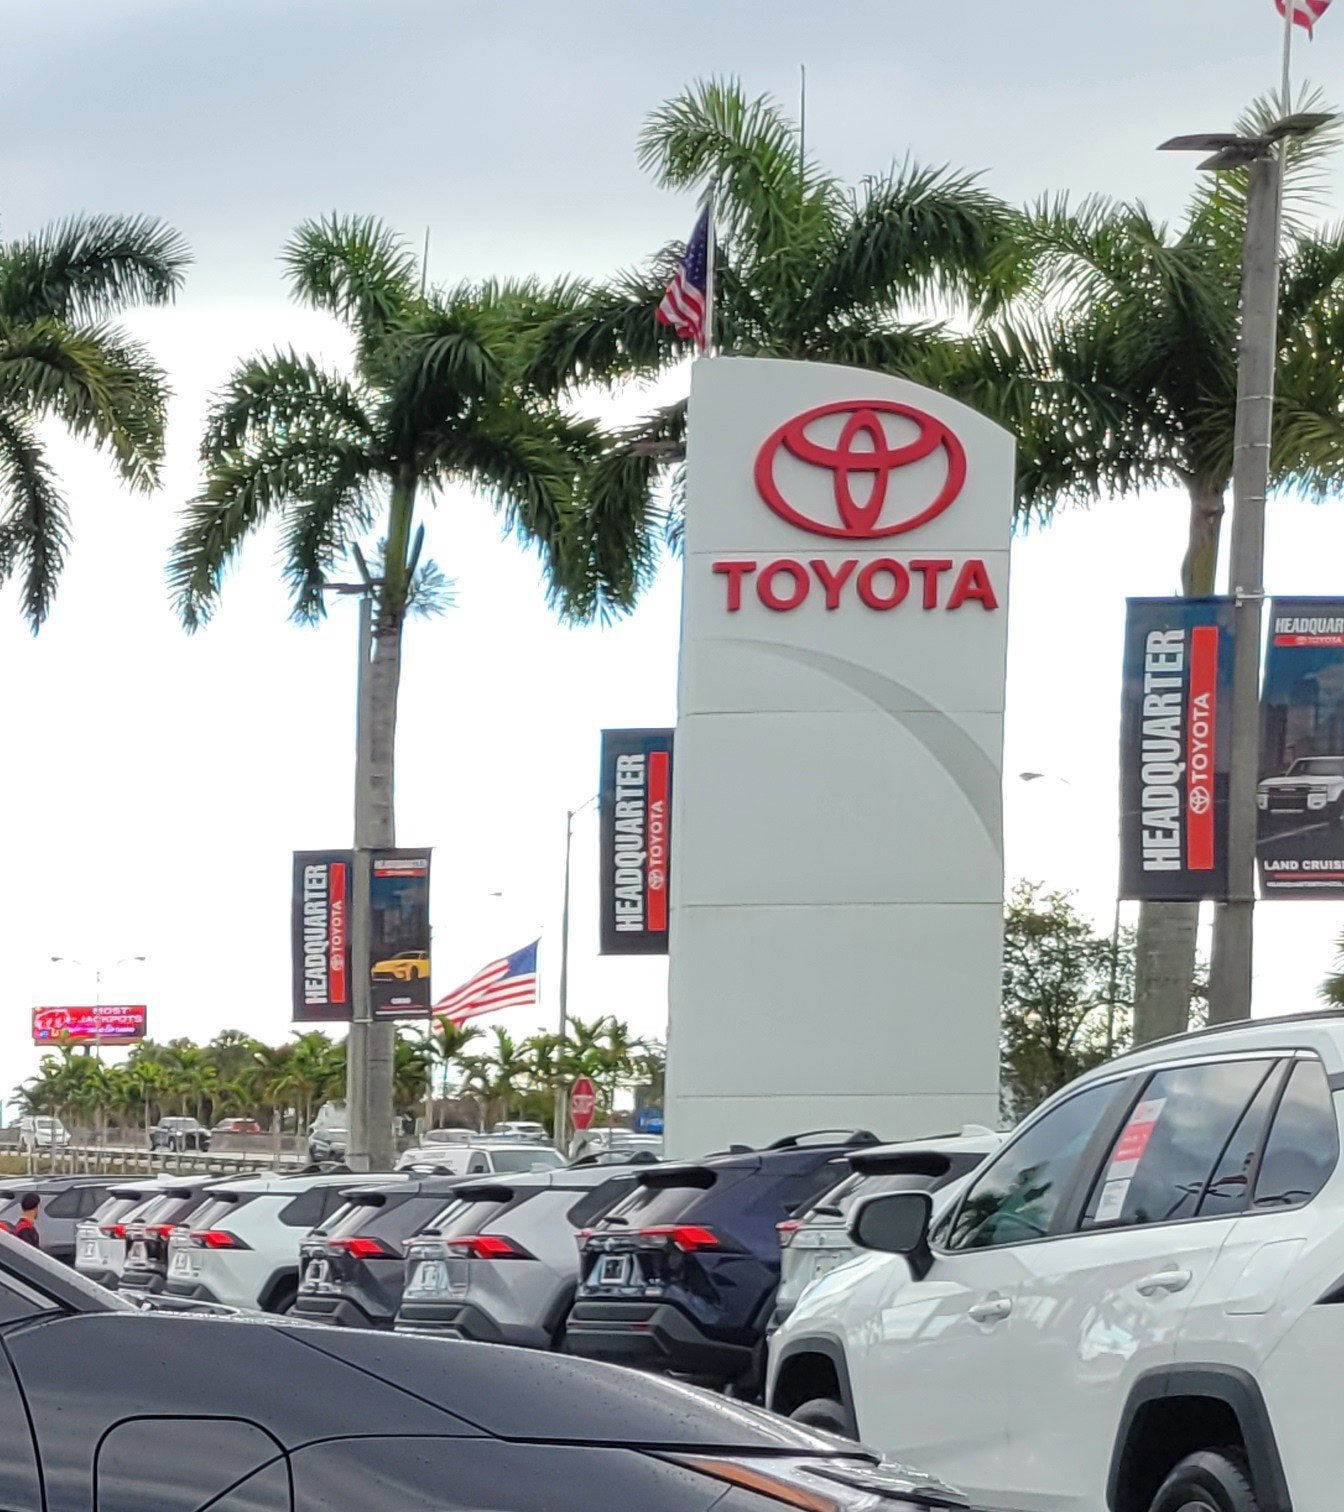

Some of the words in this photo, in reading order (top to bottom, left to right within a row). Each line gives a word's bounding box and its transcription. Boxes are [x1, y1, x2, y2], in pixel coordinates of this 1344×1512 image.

[711, 557, 1000, 612] TOYOTA
[1141, 628, 1186, 871] HEADQUARTER
[1191, 692, 1211, 784] TOYOTA
[614, 753, 647, 932] HEADQUARTER
[649, 800, 664, 867] TOYOTA
[1263, 860, 1299, 871] LAND
[304, 864, 329, 1005] HEADQUARTER
[331, 900, 343, 953] TOYOTA
